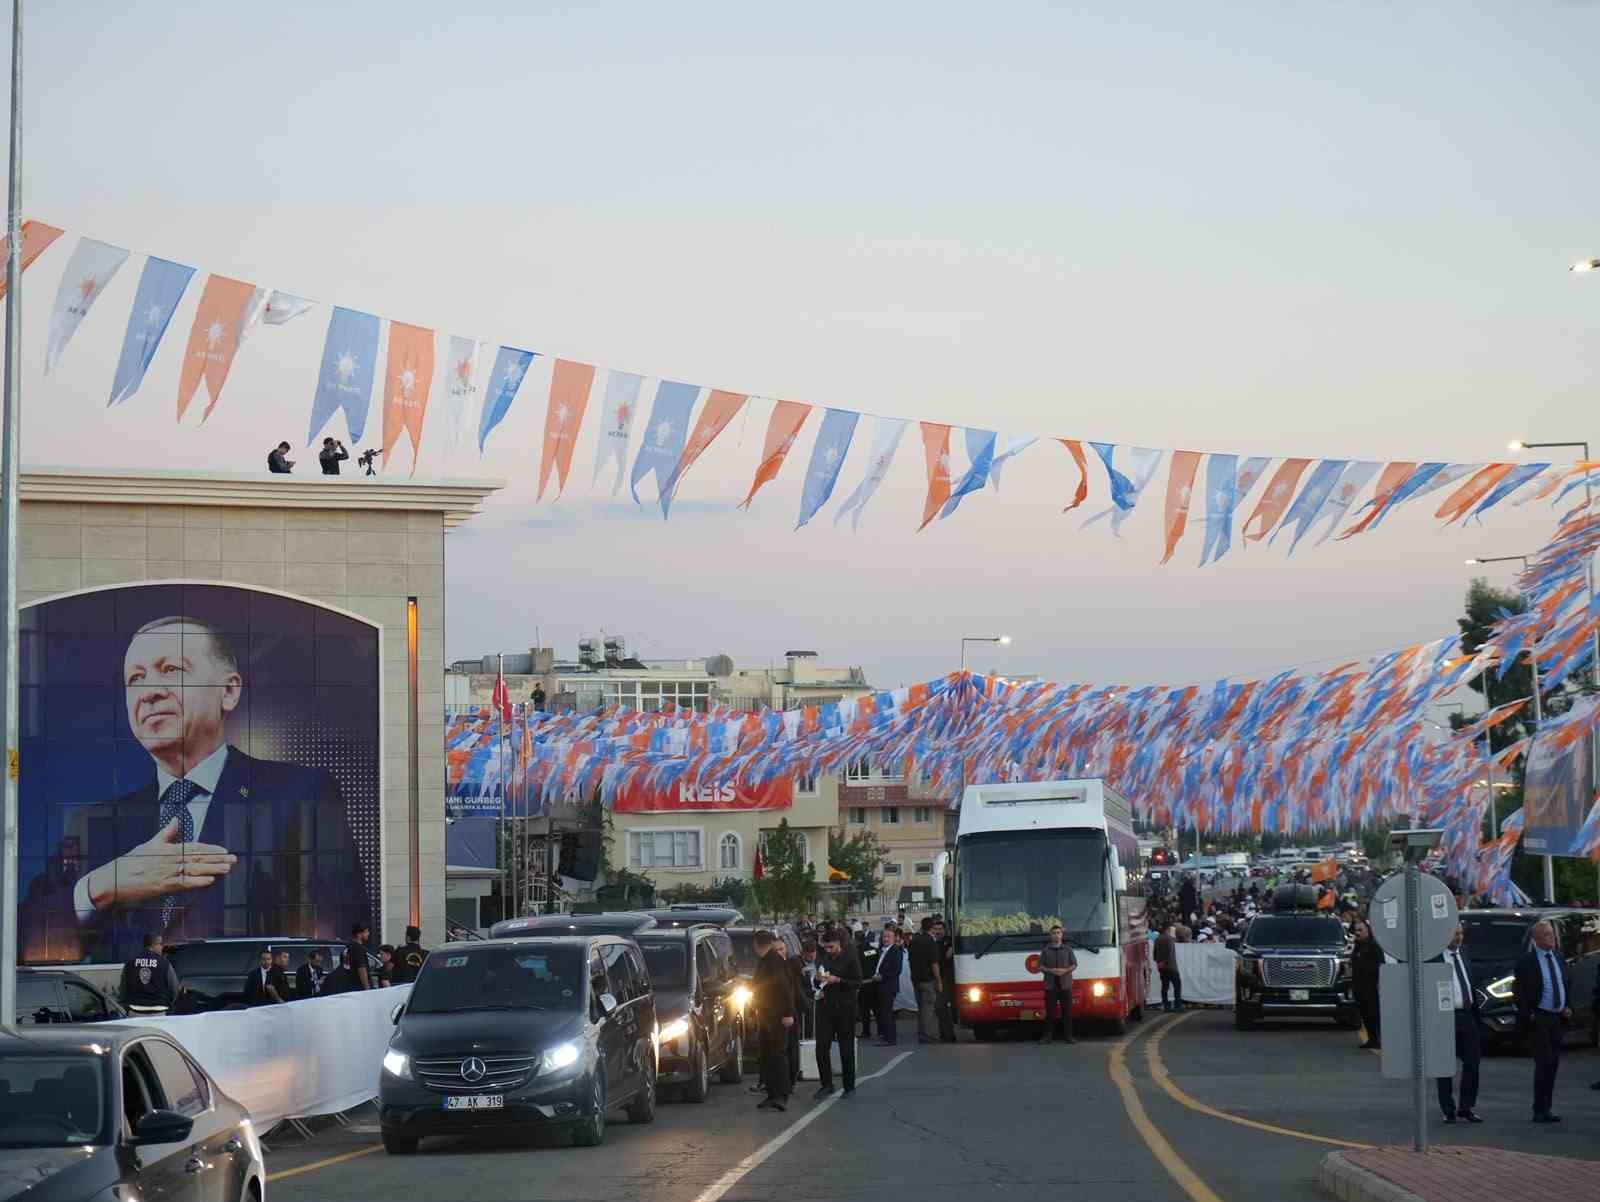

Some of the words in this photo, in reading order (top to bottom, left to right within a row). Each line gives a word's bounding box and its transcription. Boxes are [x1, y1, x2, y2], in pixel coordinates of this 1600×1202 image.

[449, 1096, 460, 1107] 47
[467, 1096, 479, 1107] AK
[486, 1096, 502, 1106] 319
